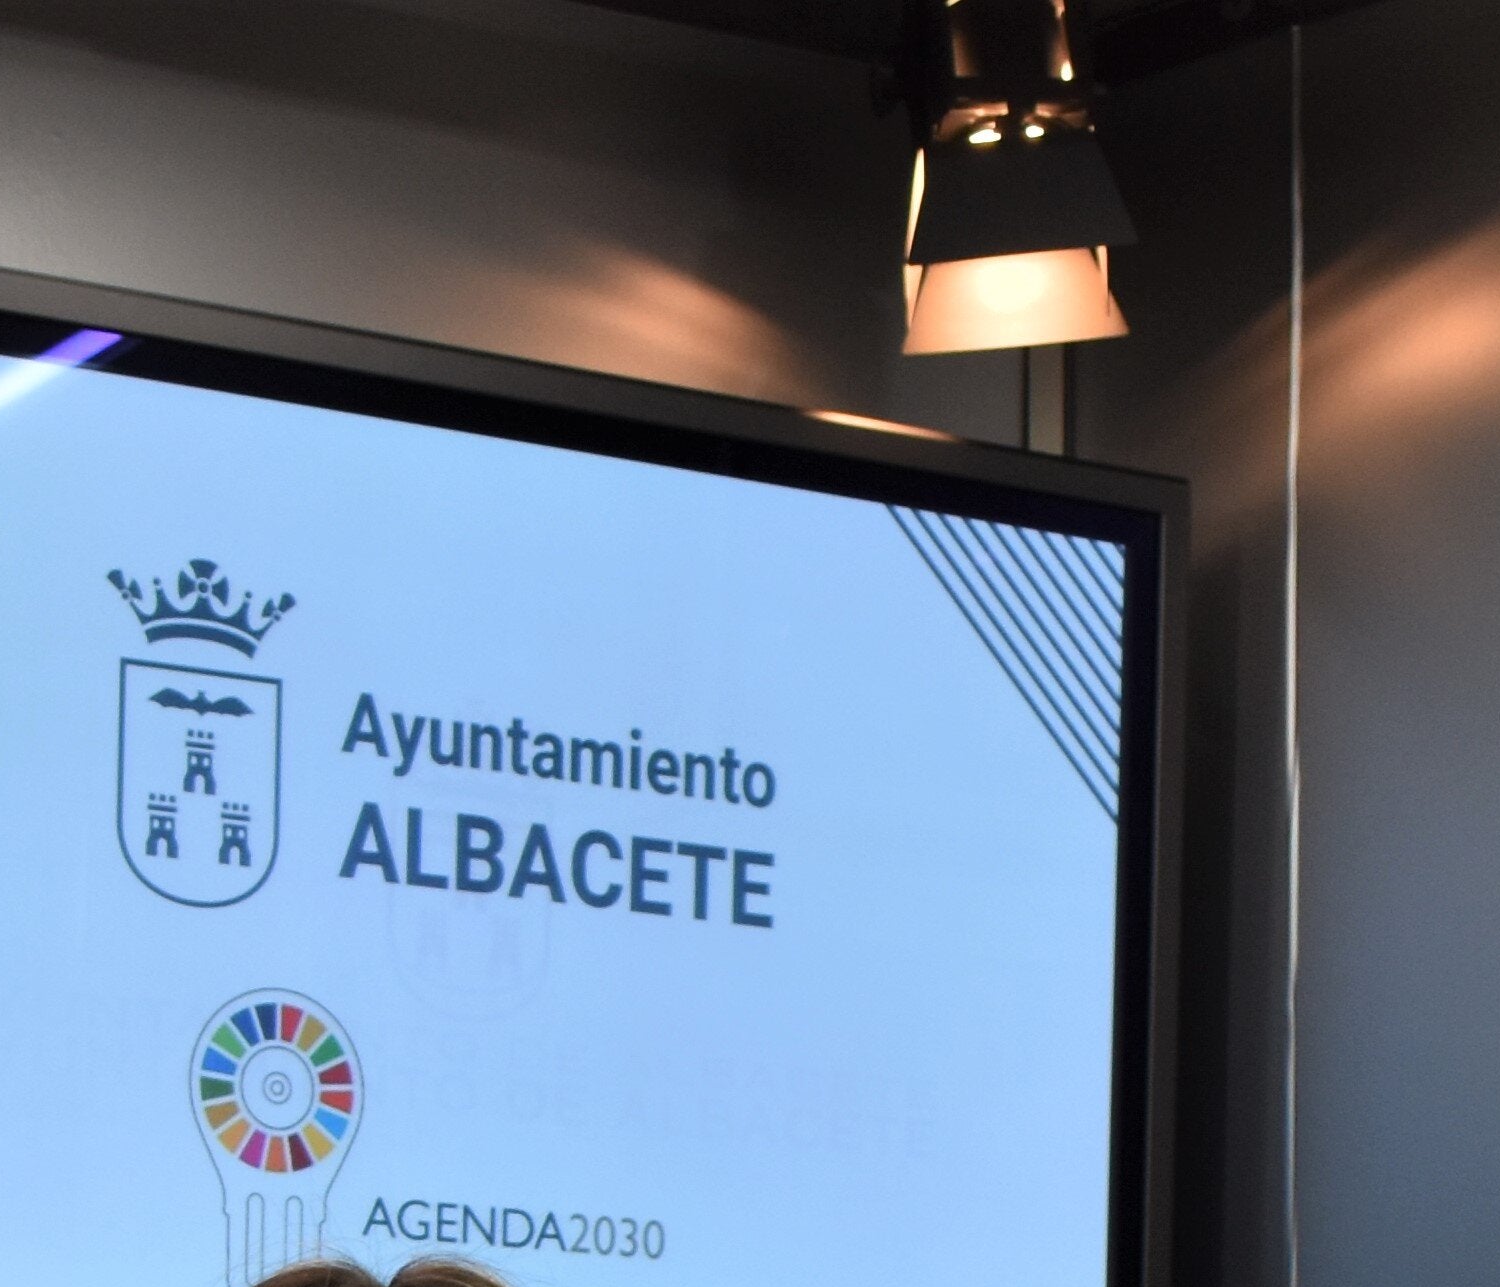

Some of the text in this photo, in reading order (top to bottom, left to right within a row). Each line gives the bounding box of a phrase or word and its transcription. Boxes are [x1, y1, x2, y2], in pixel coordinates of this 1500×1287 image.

[341, 692, 776, 808] Ayuntamiento
[339, 802, 775, 928] ALBACETE
[362, 1197, 665, 1260] AGENDA2030
